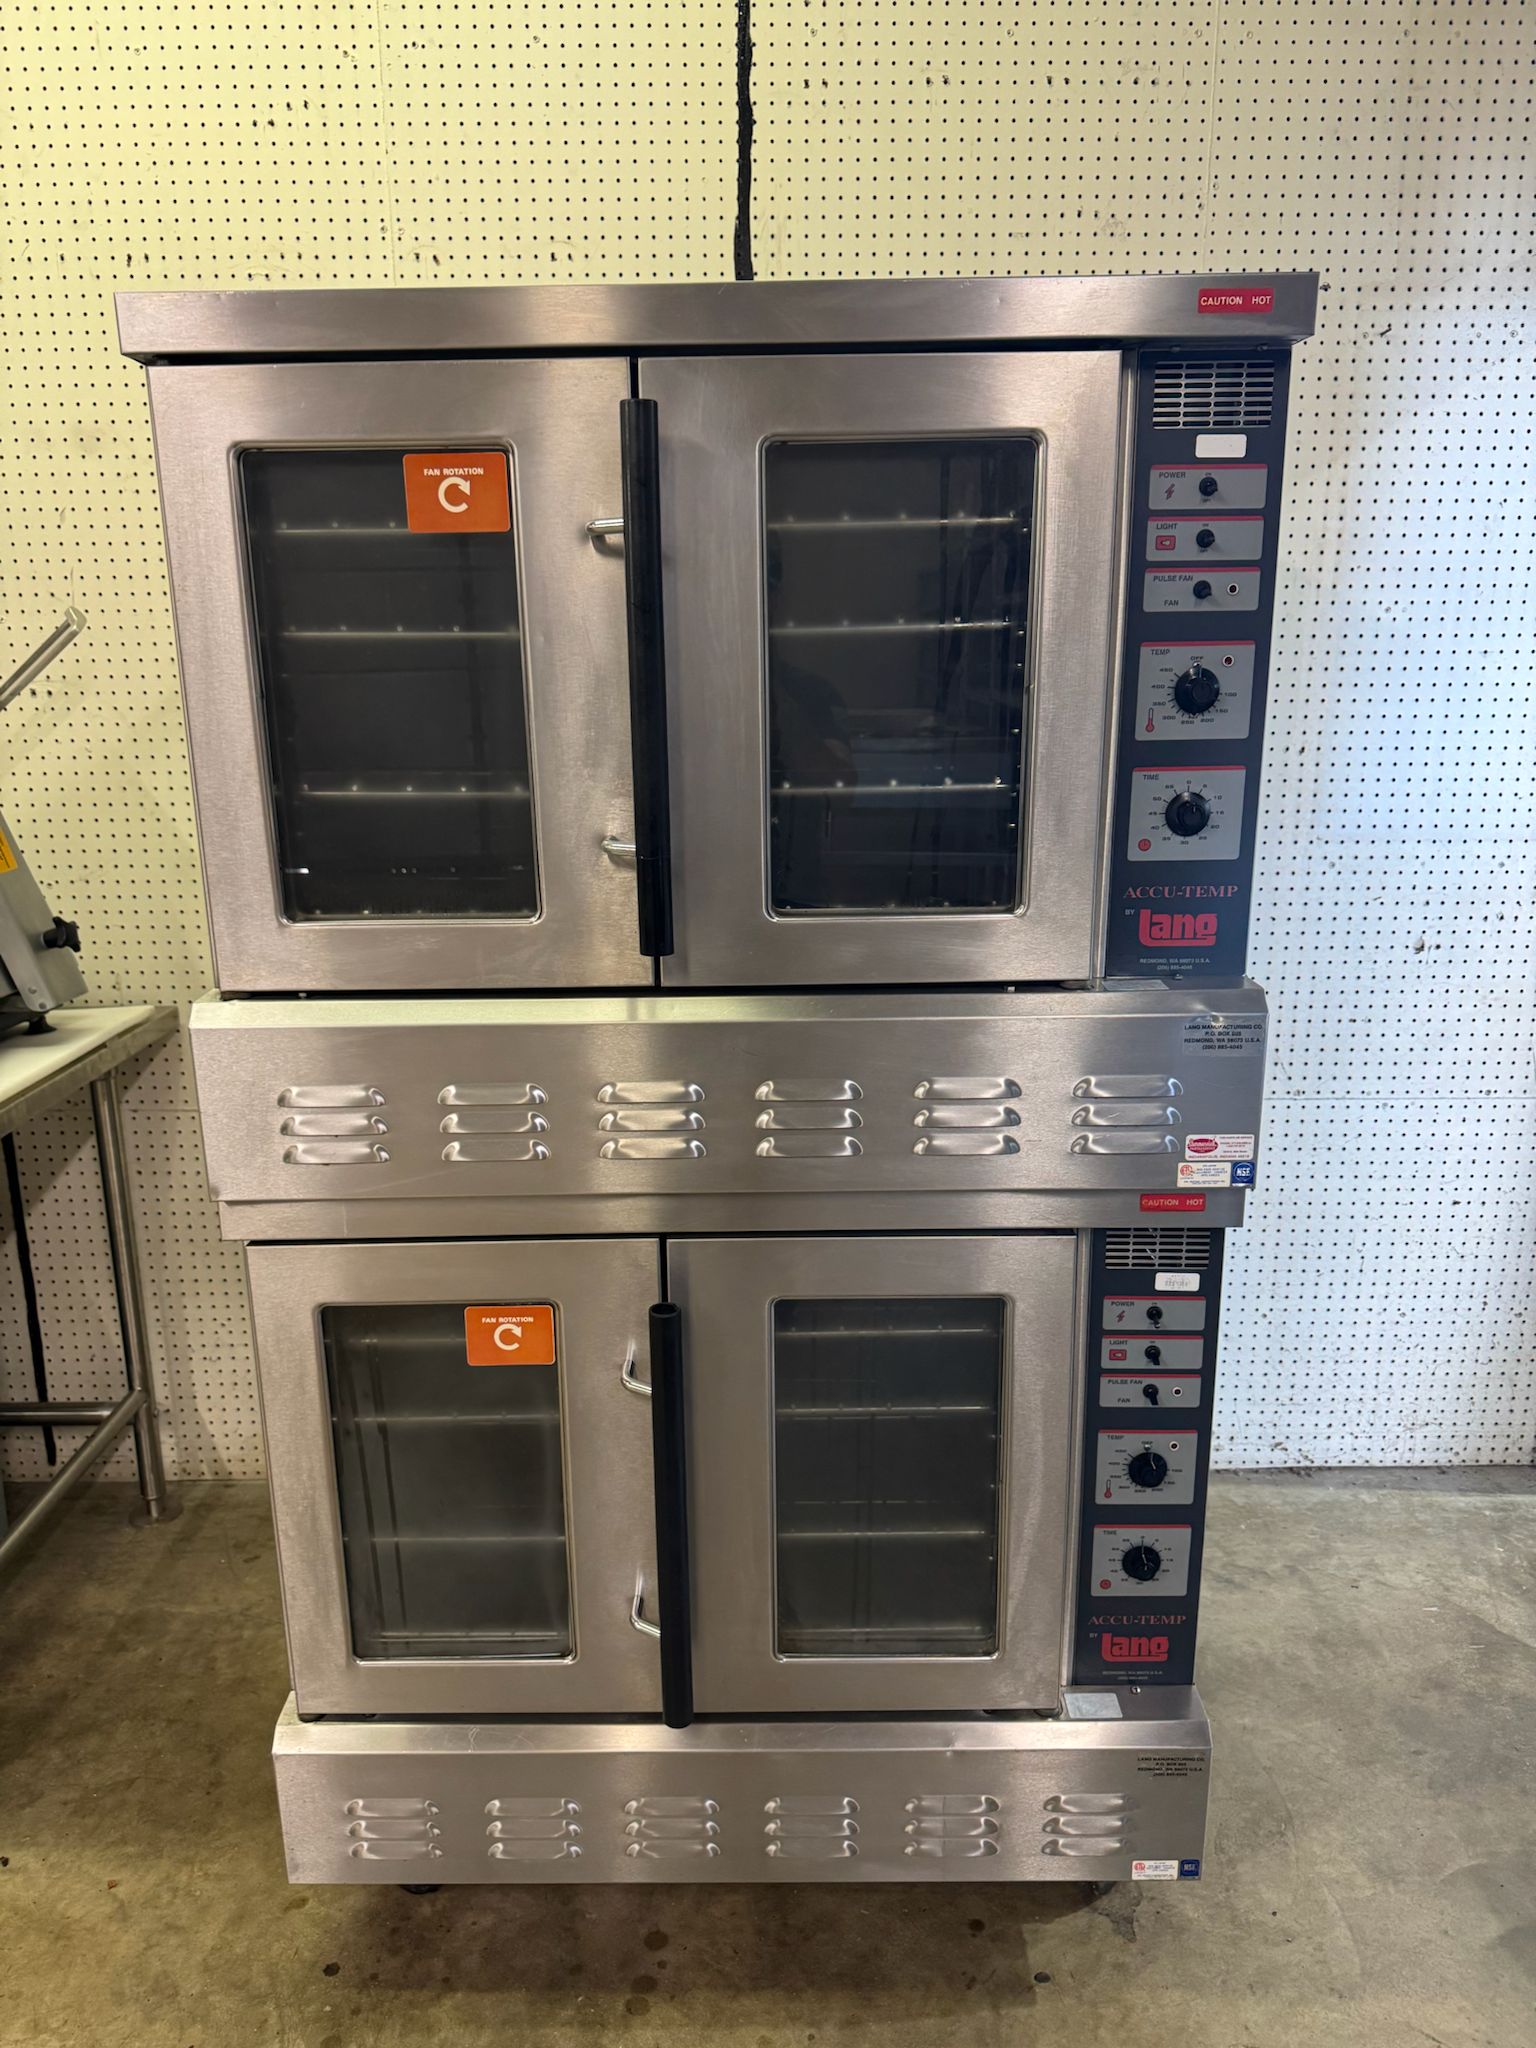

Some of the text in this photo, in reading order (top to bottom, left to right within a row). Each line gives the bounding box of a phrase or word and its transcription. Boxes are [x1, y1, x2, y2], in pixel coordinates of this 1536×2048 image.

[1200, 295, 1272, 306] CAUTION HOT
[423, 467, 484, 476] FAN ROTATION
[1158, 471, 1186, 479] POWER
[1178, 574, 1193, 582] FAN
[1150, 648, 1170, 656] TEMP
[1123, 885, 1239, 899] ACCU-TEMP
[1125, 908, 1135, 916] BY
[1142, 1198, 1204, 1206] CAUTION HOT
[1088, 1615, 1187, 1625] ACCU-TEMP
